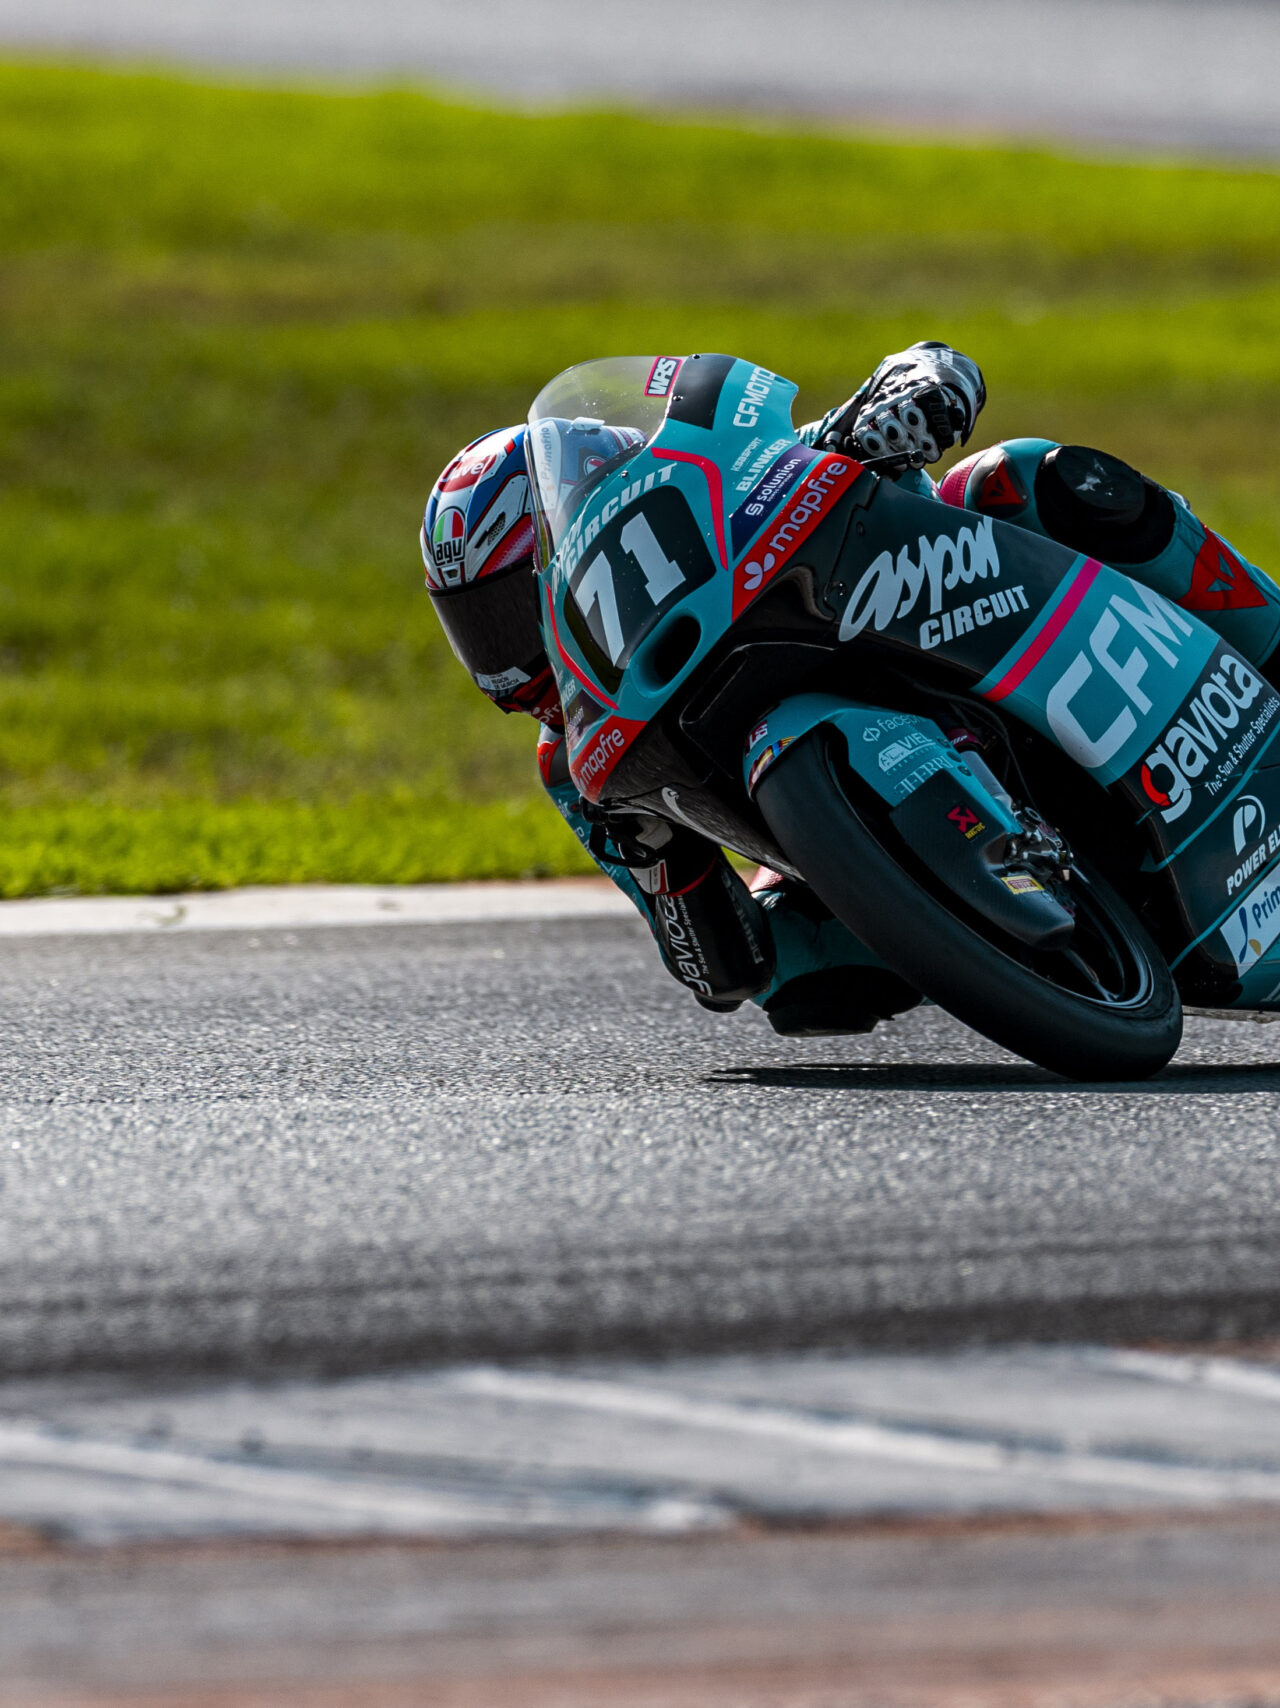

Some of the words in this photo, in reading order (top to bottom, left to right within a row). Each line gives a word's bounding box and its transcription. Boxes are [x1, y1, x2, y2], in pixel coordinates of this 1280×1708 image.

[648, 358, 677, 395] WRS
[736, 438, 792, 492] BLINKER
[757, 458, 802, 501] solunion
[565, 461, 678, 581] CIRCUIT
[769, 461, 849, 552] mapfre
[435, 538, 464, 563] agv
[574, 511, 686, 667] 71
[919, 584, 1030, 650] CIRCUIT
[1046, 577, 1193, 768] CFM
[580, 728, 625, 785] mapfre
[1141, 654, 1264, 824] gaviota
[1204, 777, 1223, 796] The
[1218, 760, 1234, 783] Sun
[1232, 728, 1257, 760] Shutter
[1249, 696, 1280, 735] Specialists
[1226, 852, 1267, 896] POWER
